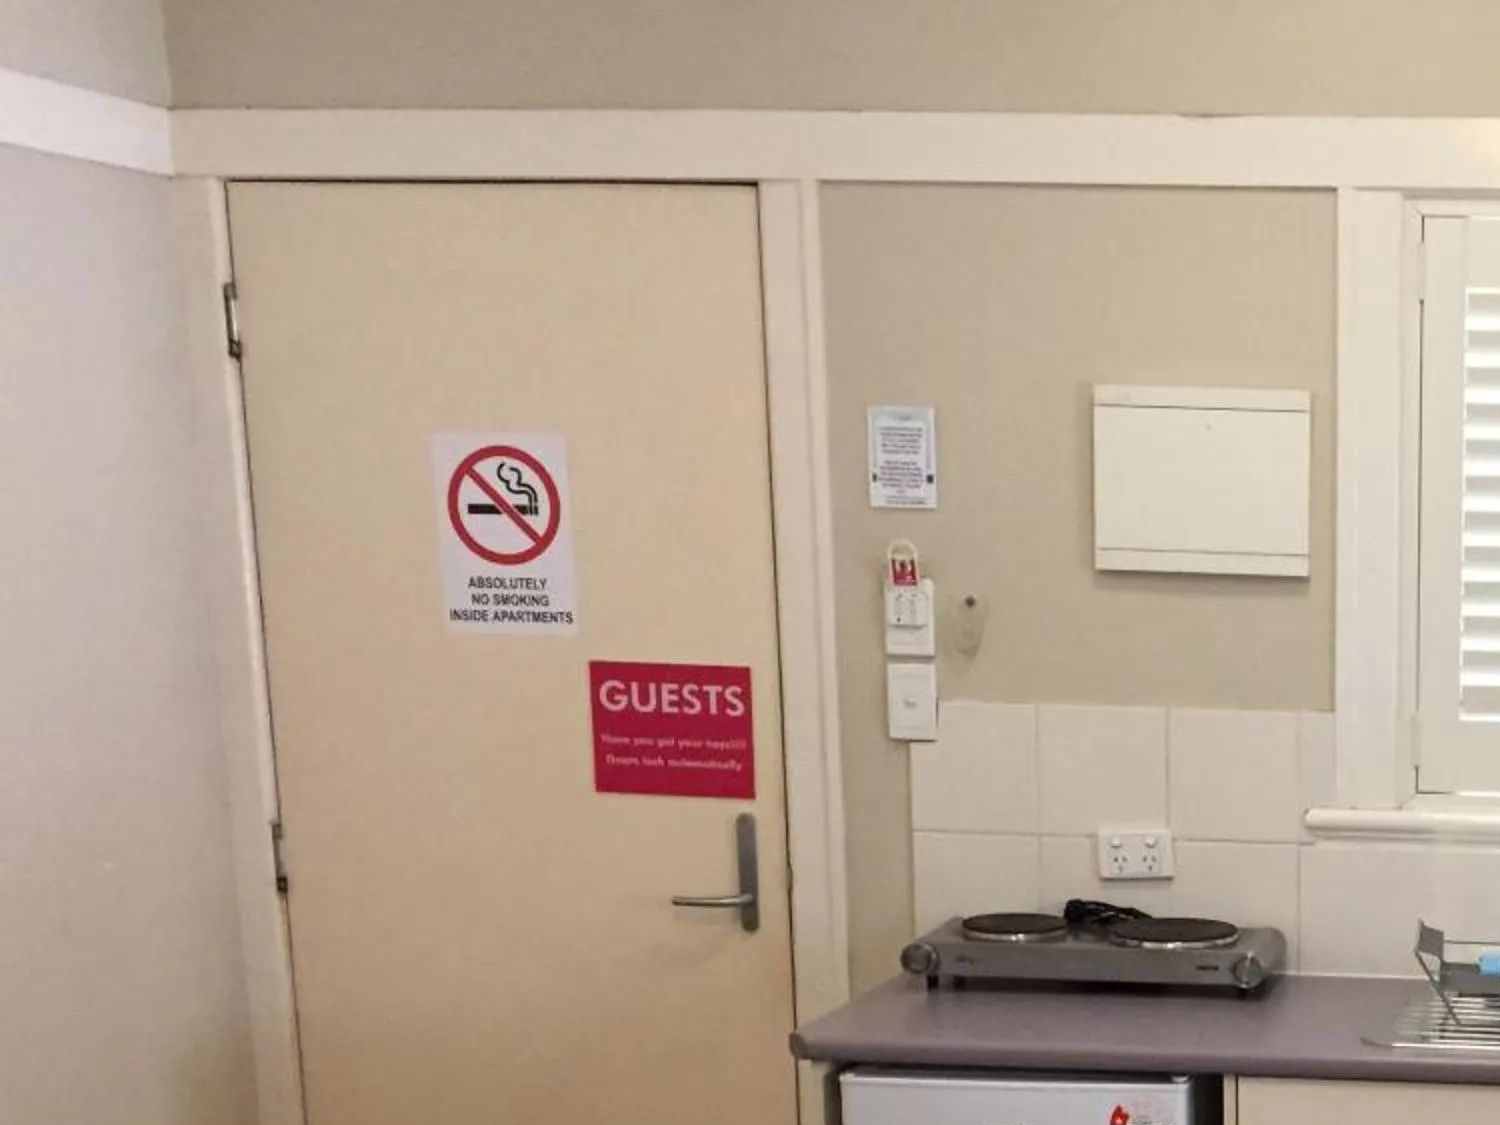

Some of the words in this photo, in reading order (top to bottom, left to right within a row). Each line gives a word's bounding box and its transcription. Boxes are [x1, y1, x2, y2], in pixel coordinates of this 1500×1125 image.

[468, 576, 548, 590] ABSOLUTELY
[471, 593, 490, 605] NO
[493, 594, 550, 607] SMOKING
[449, 608, 489, 621] INSIDE
[493, 610, 574, 624] APARTMENTS
[599, 679, 746, 717] GUESTS
[633, 737, 654, 748] you
